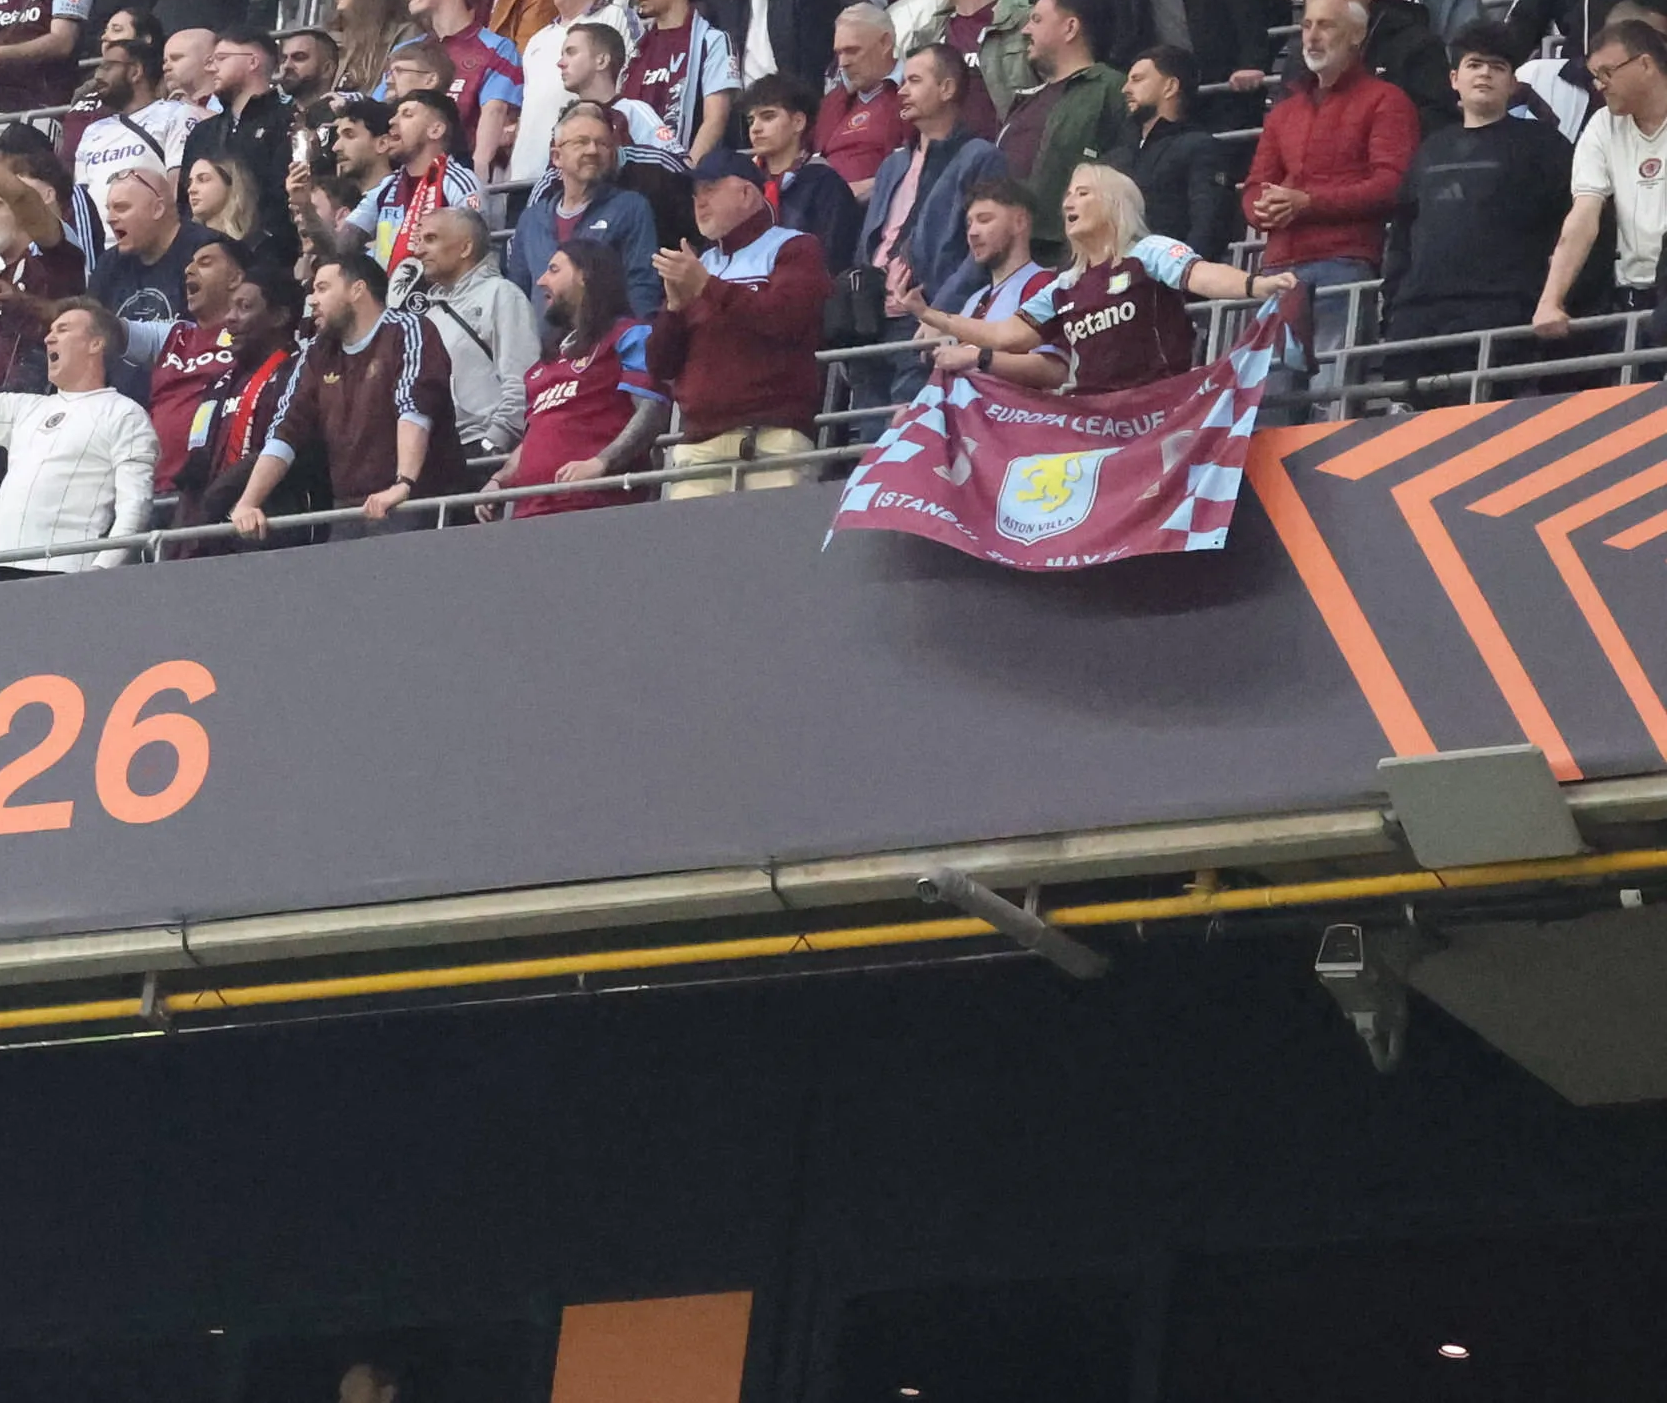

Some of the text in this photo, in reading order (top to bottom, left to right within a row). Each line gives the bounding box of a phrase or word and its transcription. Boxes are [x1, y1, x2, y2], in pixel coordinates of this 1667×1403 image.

[1063, 299, 1136, 345] Betano
[162, 350, 233, 373] AZOO
[986, 404, 1165, 438] EUROPA LEAGUE
[1002, 515, 1076, 534] ASTON VILLA
